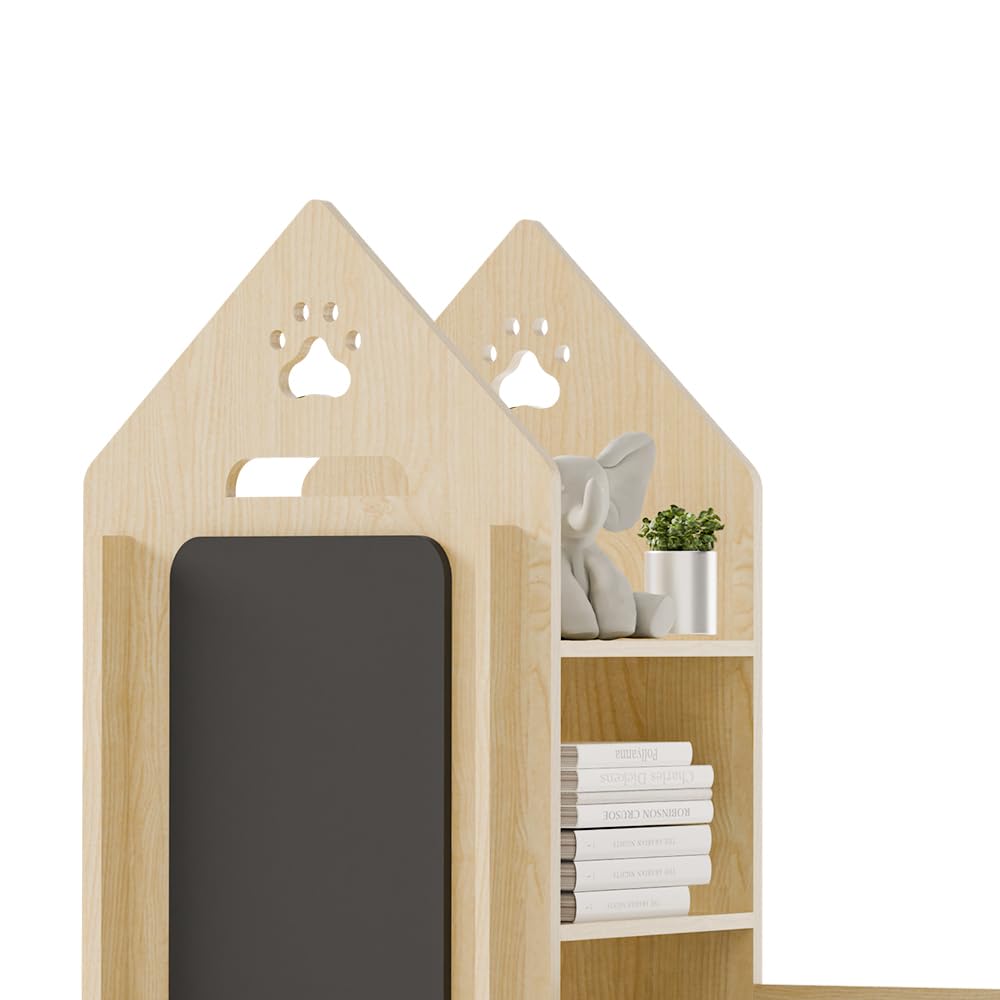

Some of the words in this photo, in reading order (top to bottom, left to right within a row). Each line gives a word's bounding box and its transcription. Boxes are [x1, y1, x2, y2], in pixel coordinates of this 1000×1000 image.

[615, 748, 658, 761] Pollyanna
[603, 808, 641, 821] CRUSOE
[644, 807, 690, 819] ROBINSON
